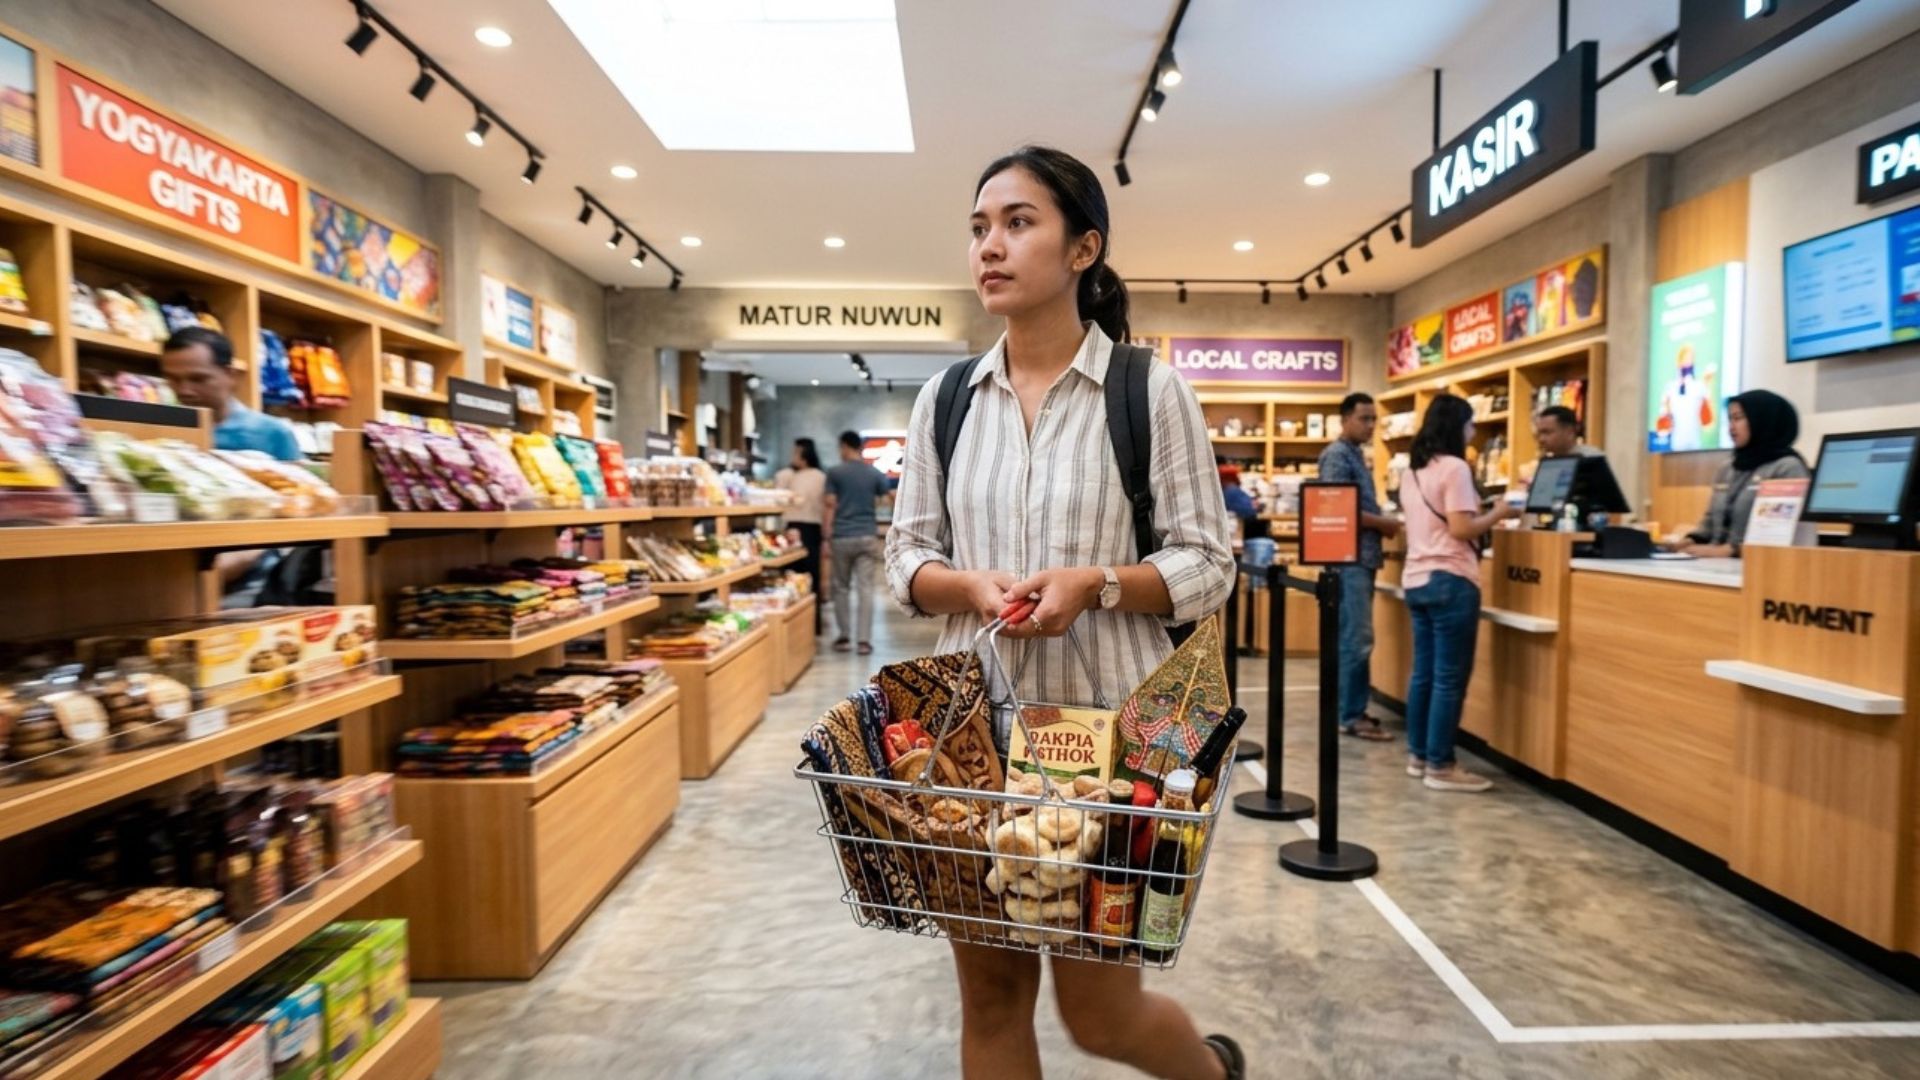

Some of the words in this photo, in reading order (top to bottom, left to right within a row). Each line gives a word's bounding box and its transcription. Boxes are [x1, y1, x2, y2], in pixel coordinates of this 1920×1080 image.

[70, 83, 289, 217] YOGYAKARTA
[1428, 98, 1538, 217] KASIR
[149, 169, 242, 234] GIFTS
[739, 305, 832, 326] MATUR
[841, 306, 942, 327] NUWUN
[1453, 301, 1494, 332] LOCAL
[1174, 349, 1249, 370] LOCAL
[1251, 350, 1339, 371] CRAFTS
[1762, 598, 1875, 636] PAYMENT
